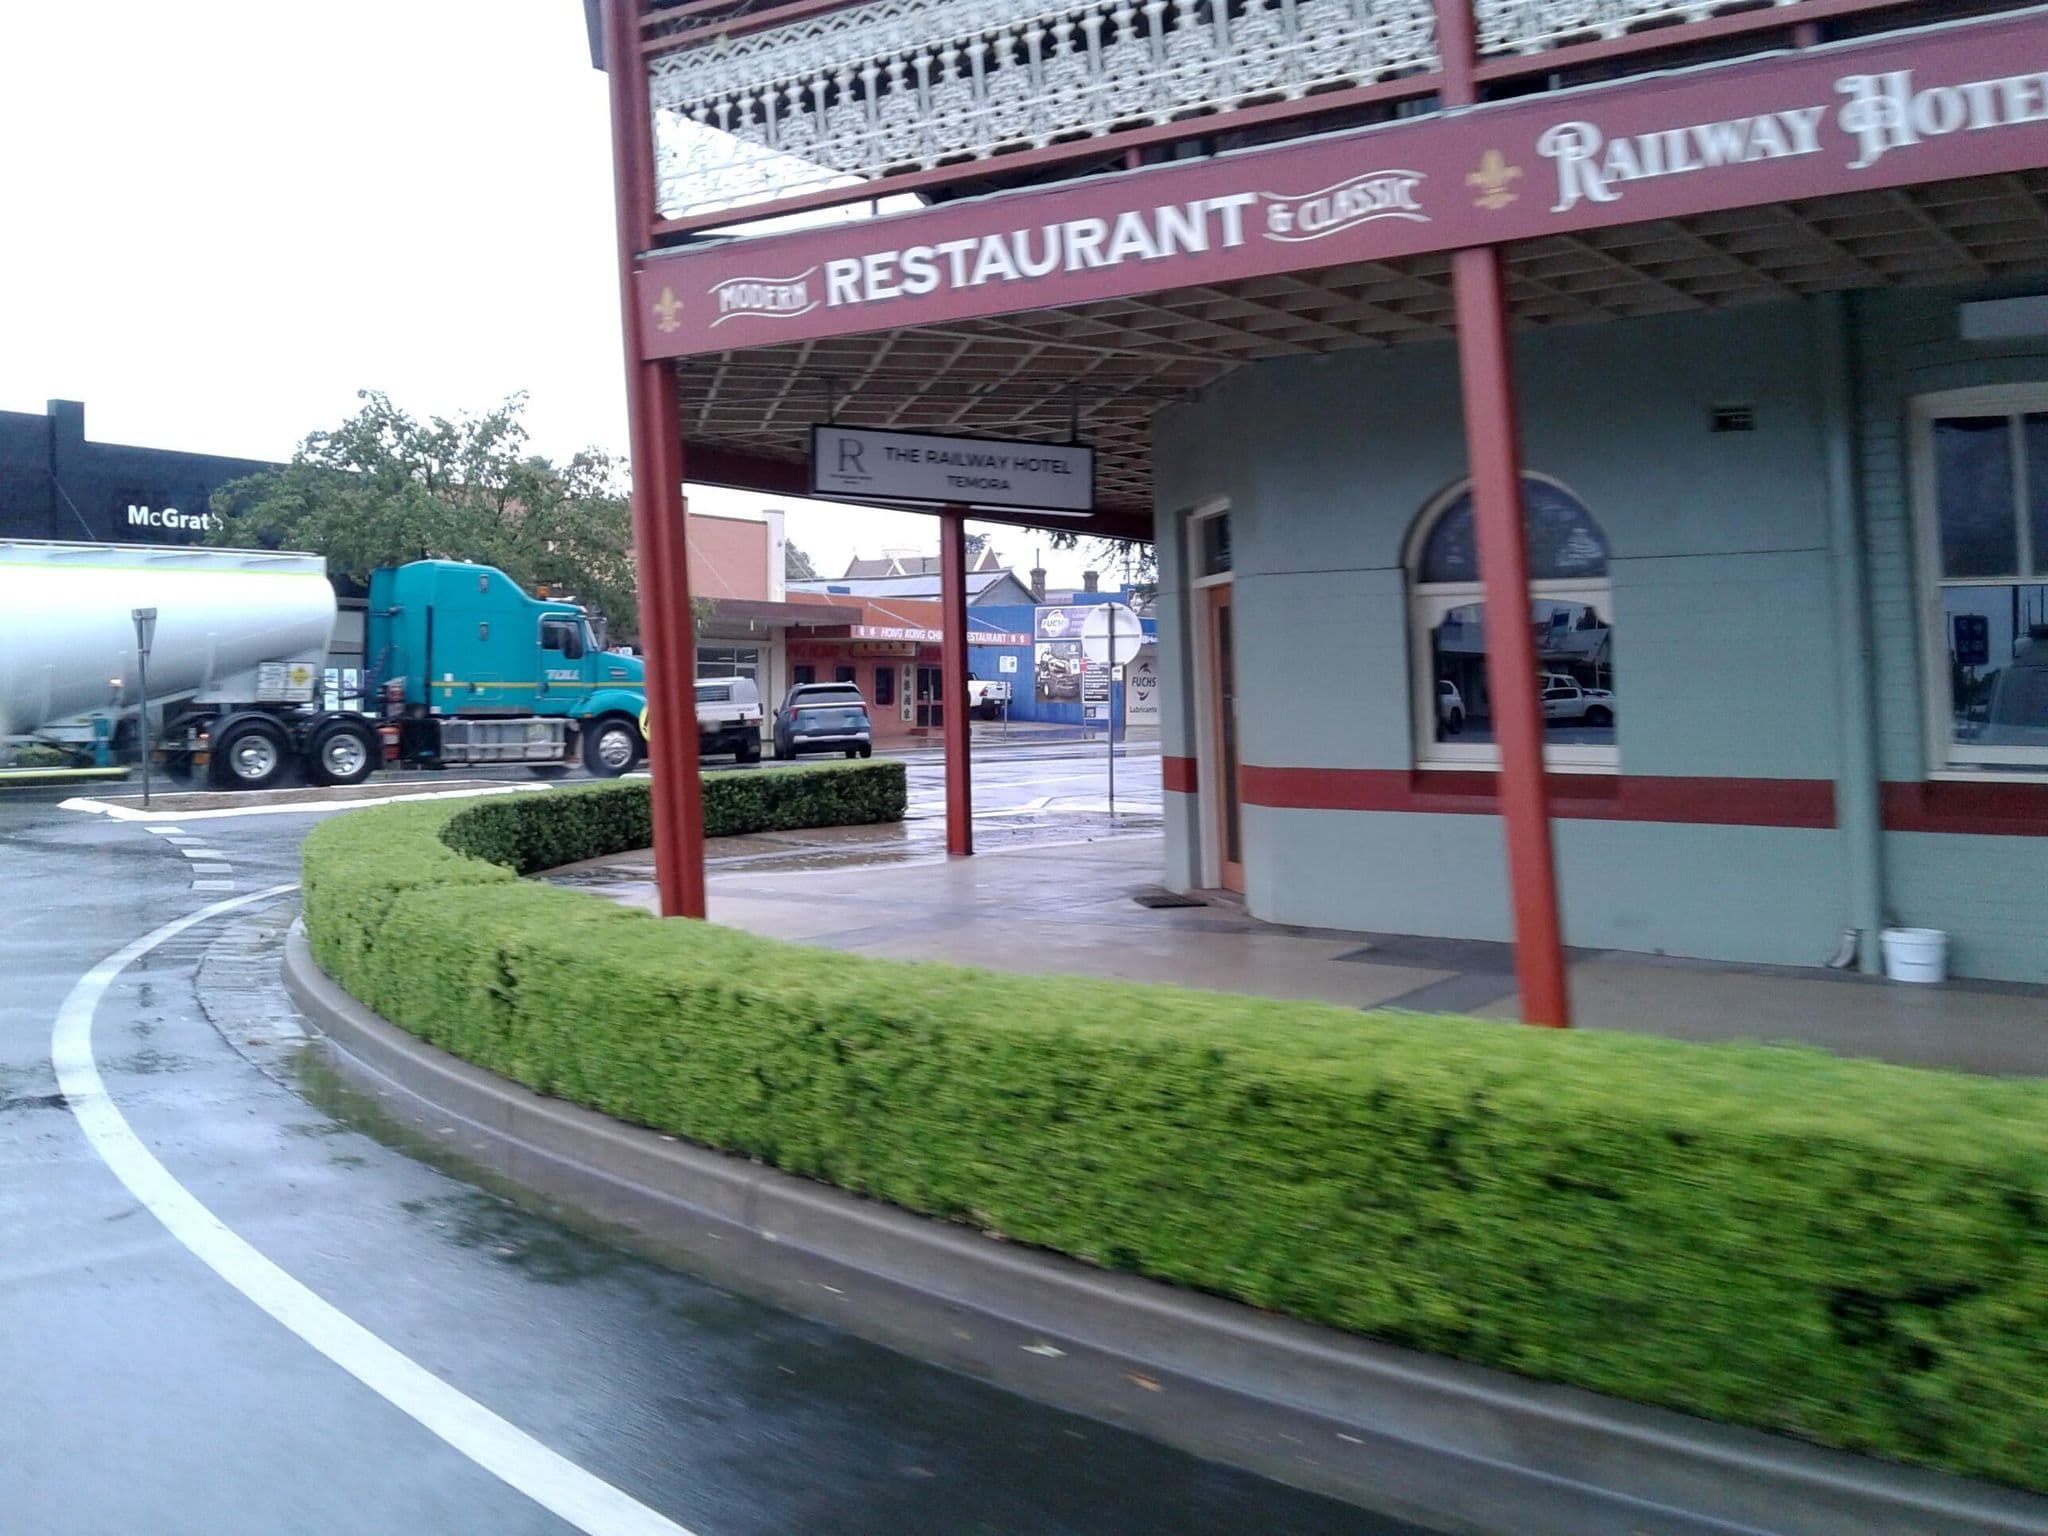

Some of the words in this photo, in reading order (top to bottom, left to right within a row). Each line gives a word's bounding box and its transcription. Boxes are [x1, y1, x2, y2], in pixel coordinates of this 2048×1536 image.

[1537, 106, 1829, 213] RAILWAY
[1834, 70, 2048, 170] HOTE
[719, 281, 808, 313] MODERN
[825, 191, 1258, 307] RESTAURANT
[1267, 203, 1296, 232] &
[1298, 177, 1423, 232] CLASSIC
[838, 438, 866, 473] R
[884, 447, 921, 463] THE
[926, 450, 1008, 469] RAILWAY
[1013, 457, 1072, 475] HOTEL
[946, 474, 1012, 491] TEMORA
[881, 627, 903, 638] HONG
[904, 628, 926, 640] KONG
[966, 631, 1007, 643] ESTAURANT
[1131, 676, 1157, 688] FUCHS
[1129, 705, 1158, 714] Lubricants
